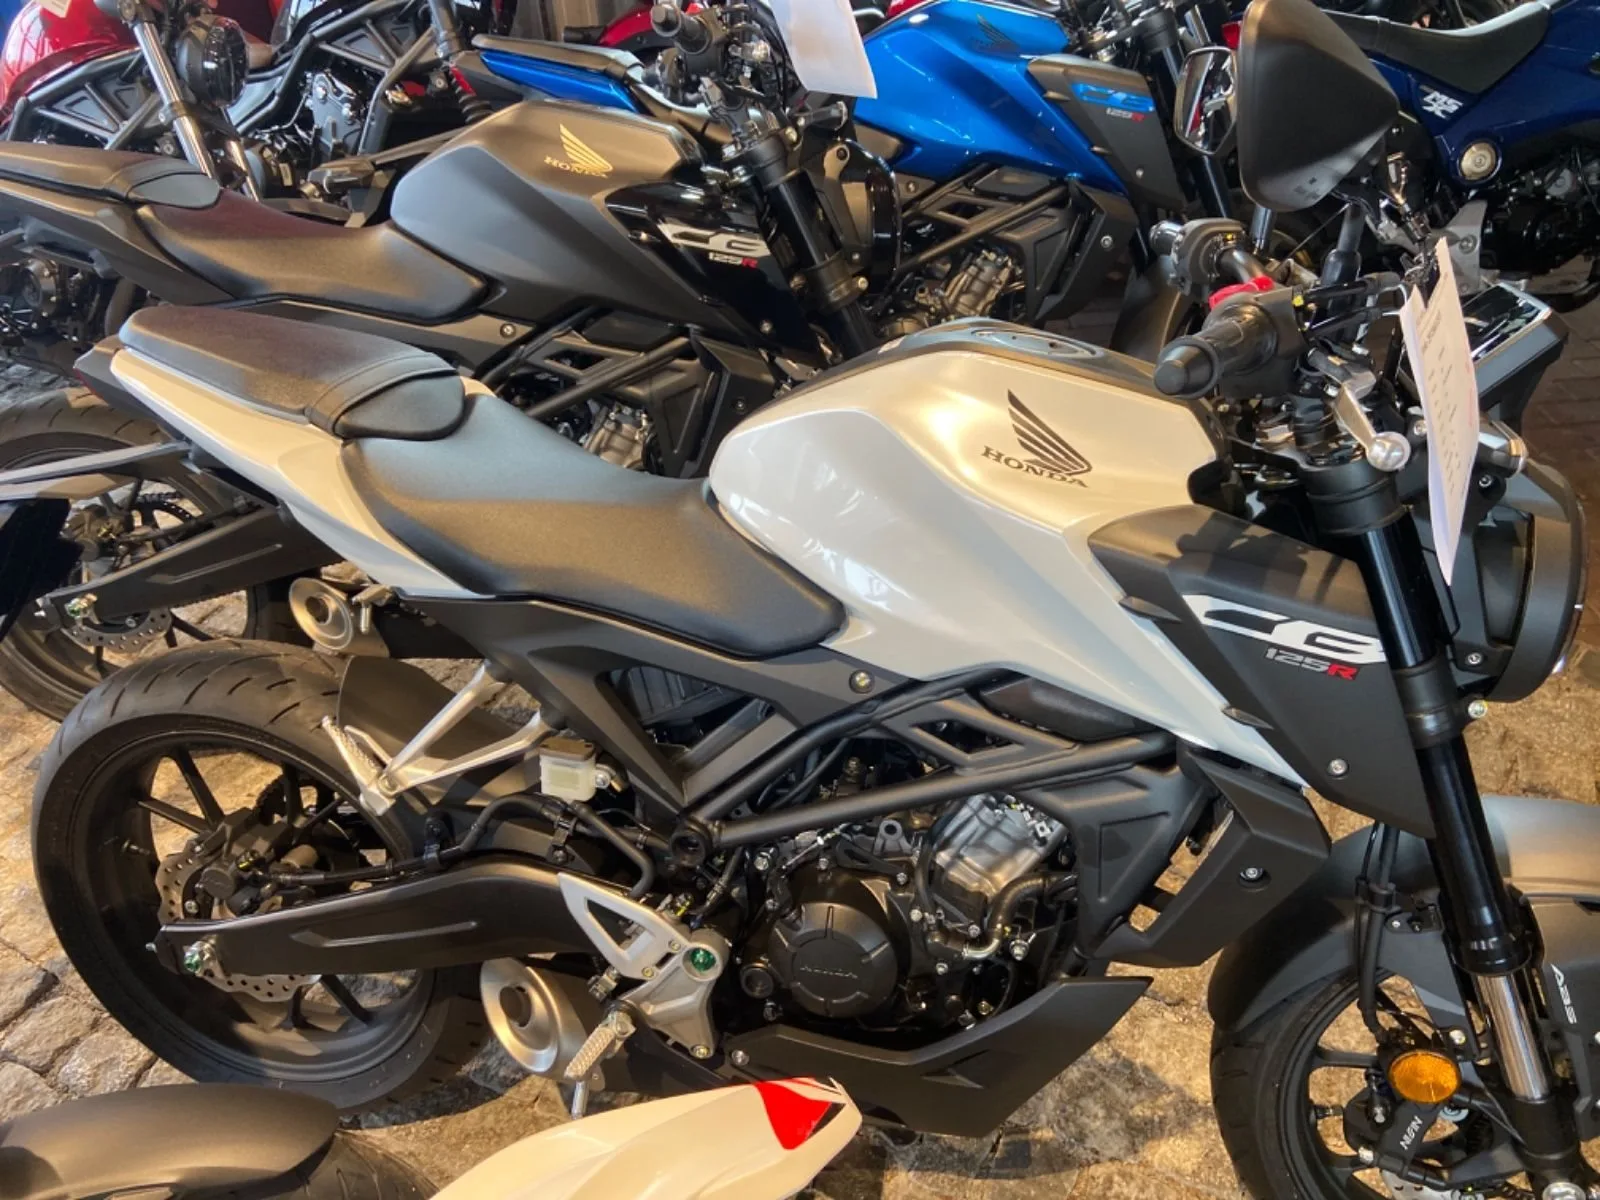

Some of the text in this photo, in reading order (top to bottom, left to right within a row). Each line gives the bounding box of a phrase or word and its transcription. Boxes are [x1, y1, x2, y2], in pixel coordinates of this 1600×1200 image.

[981, 445, 1089, 488] HONDA
[1264, 648, 1360, 680] 125R
[1550, 963, 1577, 1025] ABS
